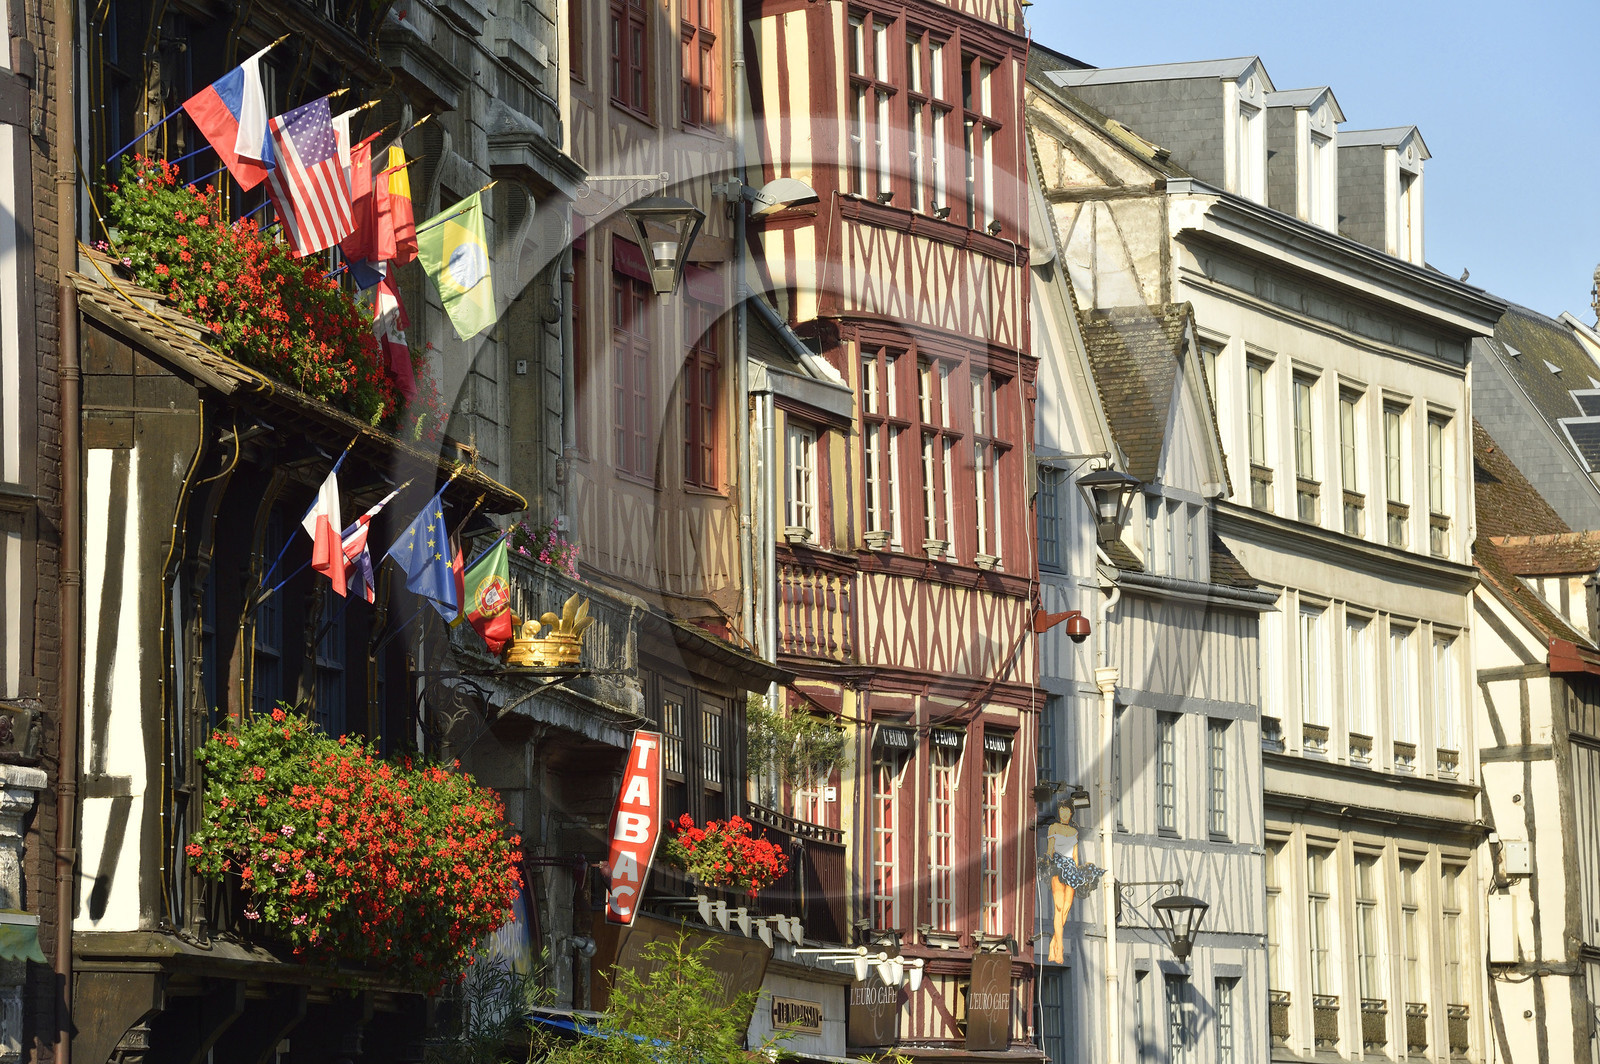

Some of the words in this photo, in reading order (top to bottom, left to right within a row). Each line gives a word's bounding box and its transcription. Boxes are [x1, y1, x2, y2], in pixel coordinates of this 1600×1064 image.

[883, 728, 908, 747] L'EURO
[934, 729, 958, 747] L'EURO
[984, 735, 1006, 752] L'EURO
[608, 739, 657, 916] TABAC
[850, 987, 877, 1006] L'EURO
[969, 993, 993, 1010] L'EURO
